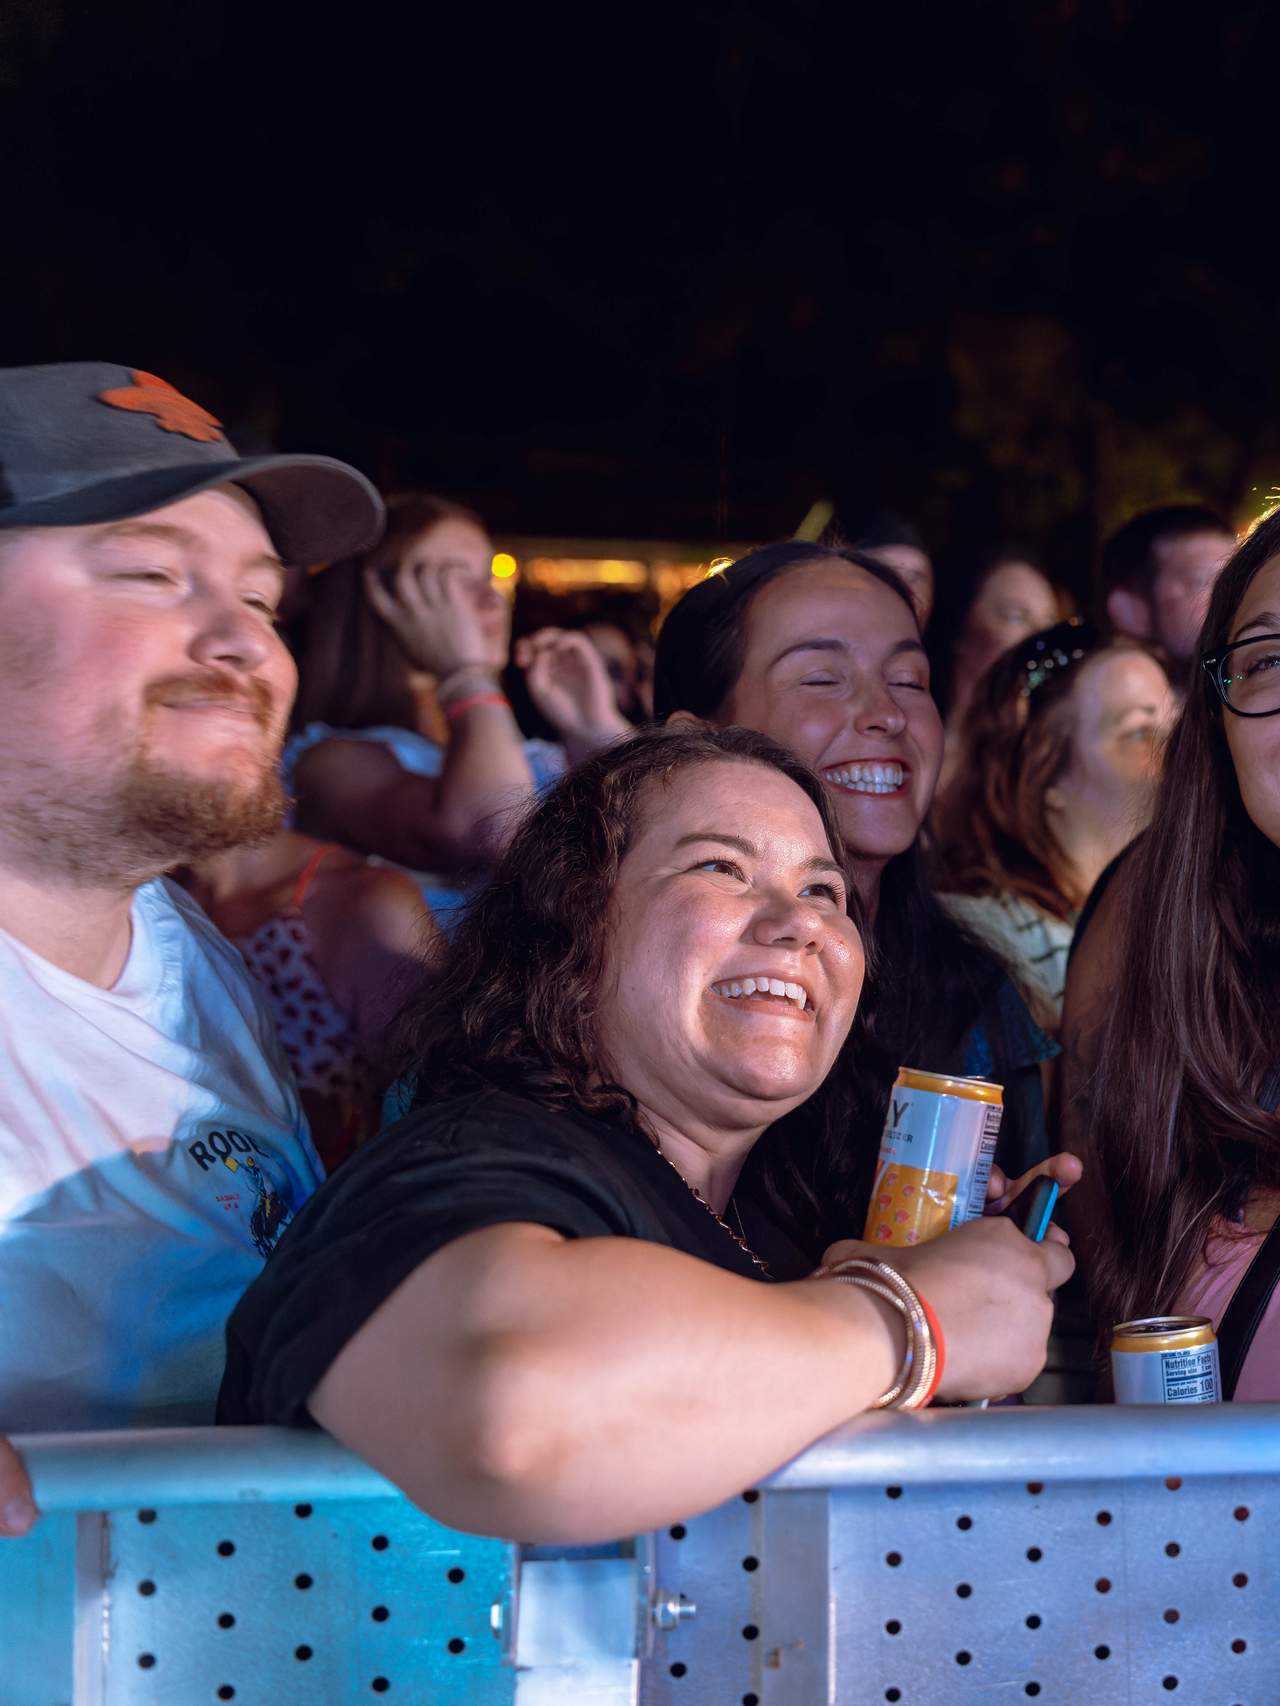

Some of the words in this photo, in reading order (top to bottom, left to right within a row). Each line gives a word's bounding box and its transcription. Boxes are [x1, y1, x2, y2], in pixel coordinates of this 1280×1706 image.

[1165, 1358, 1196, 1369] Nutrition
[1197, 1354, 1212, 1365] Facts
[1166, 1369, 1187, 1377] Serving
[1167, 1386, 1198, 1397] Calories
[1200, 1378, 1214, 1391] 100
